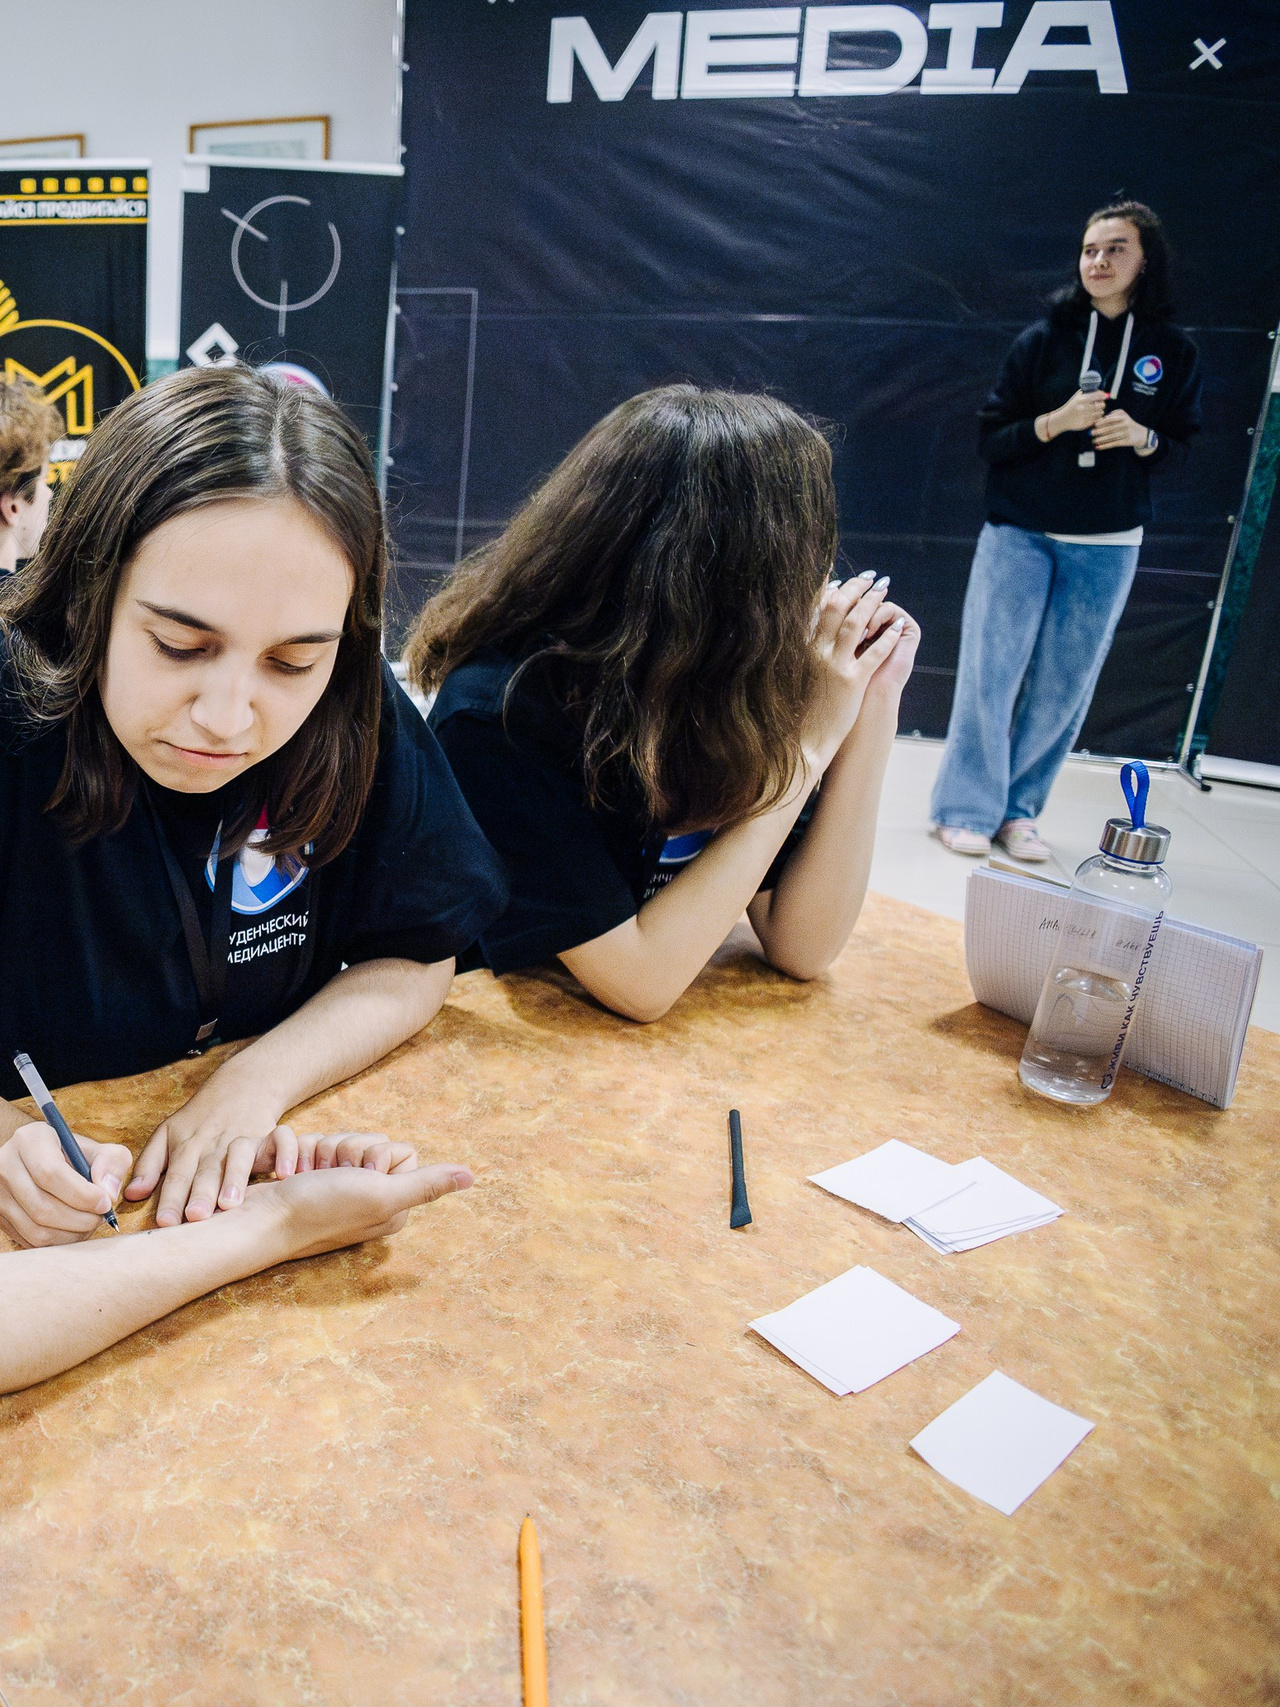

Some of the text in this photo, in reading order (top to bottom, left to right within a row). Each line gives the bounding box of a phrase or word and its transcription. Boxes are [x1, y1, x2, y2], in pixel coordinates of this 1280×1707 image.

[547, 1, 1128, 103] MEDIA
[229, 910, 309, 946] УДЕНЧЕСКИЙ
[1121, 1004, 1135, 1029] КАК
[1129, 910, 1164, 1002] ЧУВСТВУЕШЬ
